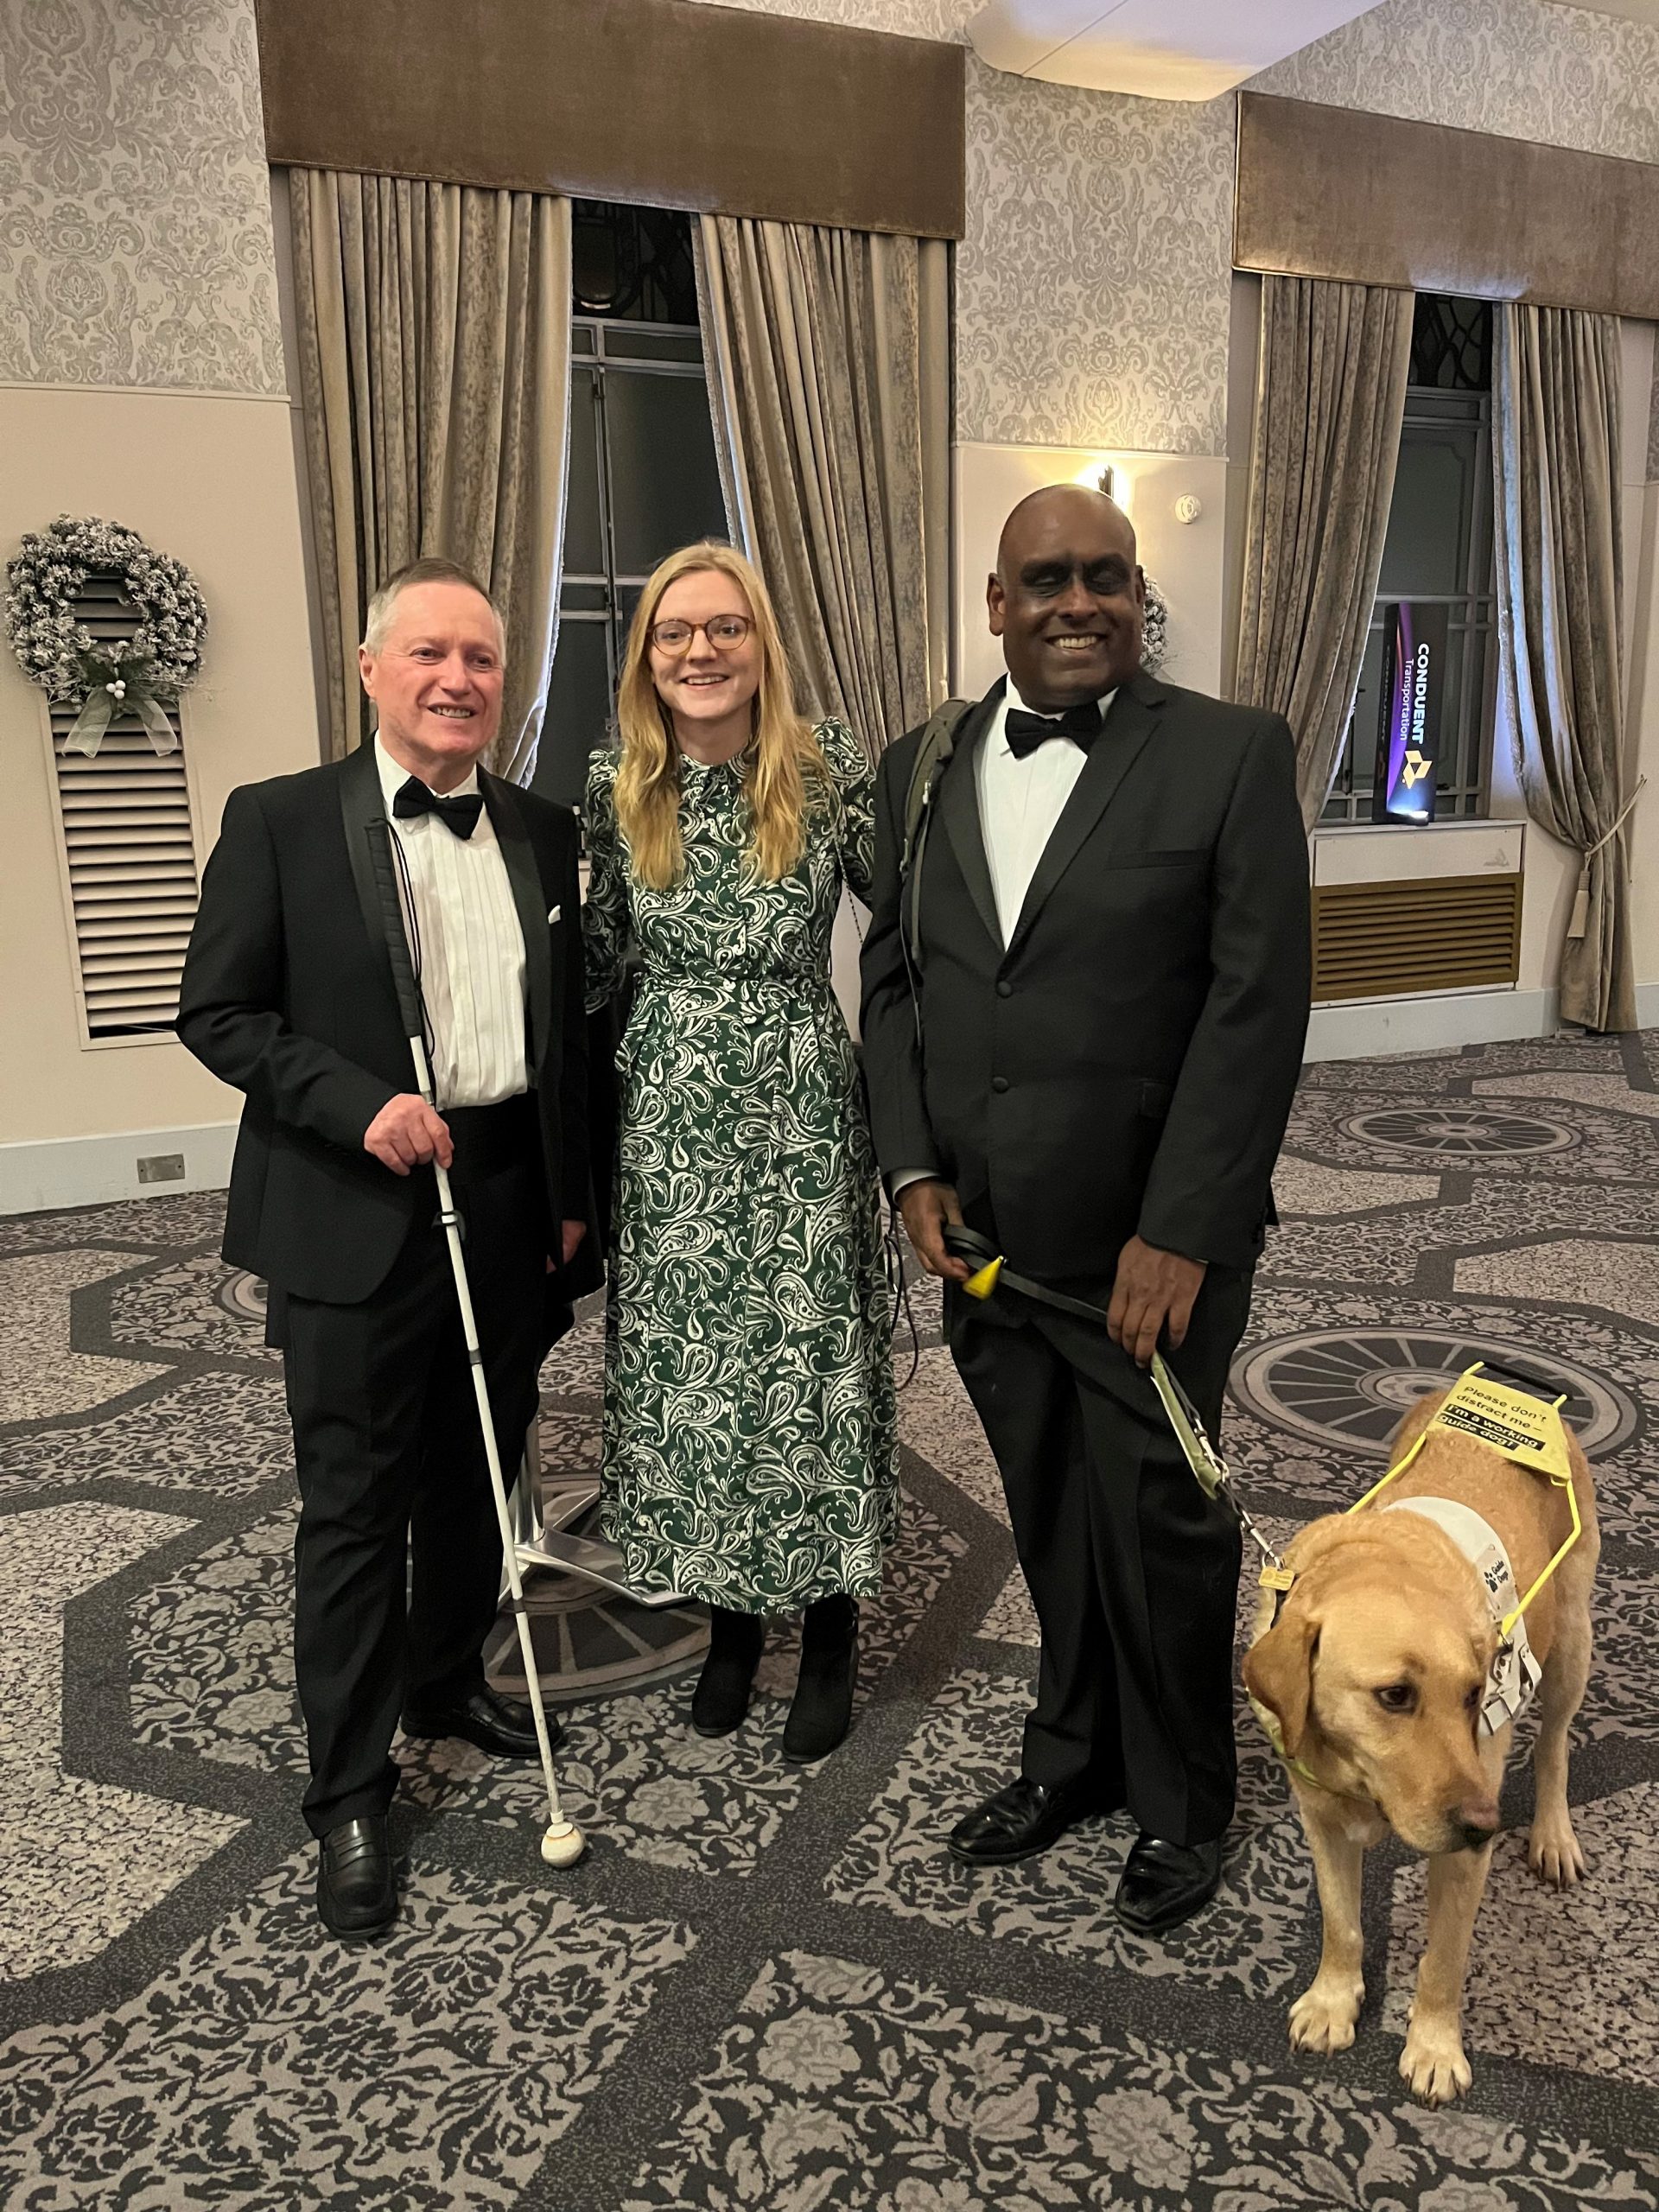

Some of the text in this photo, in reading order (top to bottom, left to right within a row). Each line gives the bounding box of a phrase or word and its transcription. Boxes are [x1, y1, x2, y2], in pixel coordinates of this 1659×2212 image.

[1400, 658, 1414, 741] Transportation
[1412, 643, 1430, 745] CONDUENT
[1457, 1394, 1507, 1419] distract
[1510, 1416, 1531, 1429] me
[1464, 1386, 1547, 1423] Please don't
[1438, 1414, 1513, 1447] guide dog!
[1448, 1404, 1469, 1418] I'm
[1484, 1420, 1539, 1449] working
